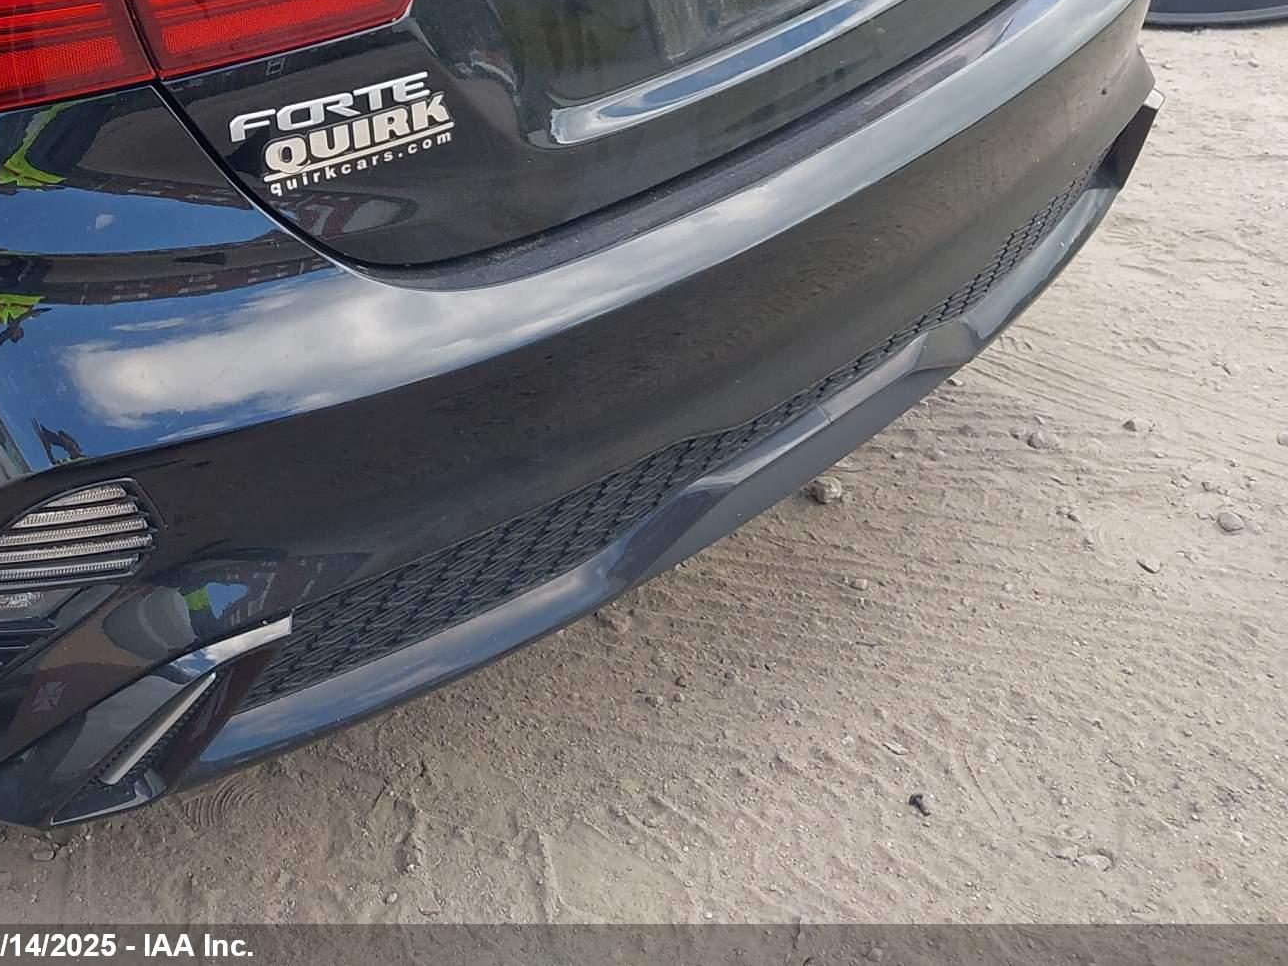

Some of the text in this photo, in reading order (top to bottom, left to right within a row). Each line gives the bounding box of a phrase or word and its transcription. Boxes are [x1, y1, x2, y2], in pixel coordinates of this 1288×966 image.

[229, 71, 431, 143] FORTE
[264, 92, 452, 175] QUIRK
[270, 131, 453, 196] quirkcars.com
